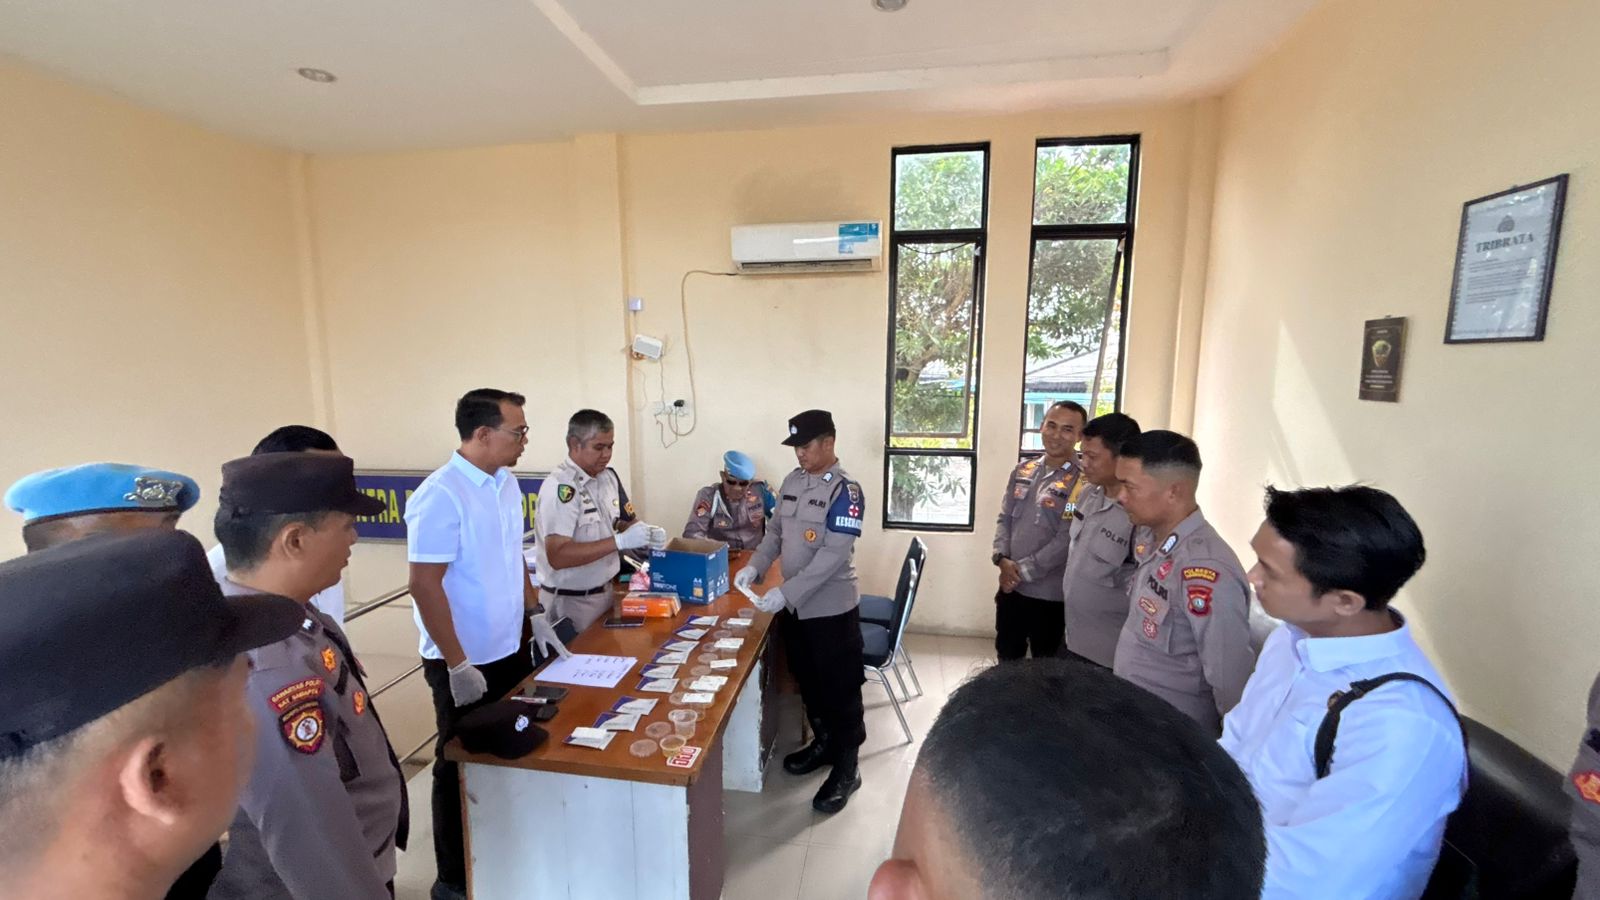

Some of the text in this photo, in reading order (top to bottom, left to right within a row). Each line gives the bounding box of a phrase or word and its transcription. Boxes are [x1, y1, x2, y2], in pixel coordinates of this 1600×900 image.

[1475, 233, 1534, 253] TRIBRATA
[808, 498, 826, 508] POLRI
[1100, 527, 1128, 547] POLRI
[1147, 574, 1169, 601] POLRI
